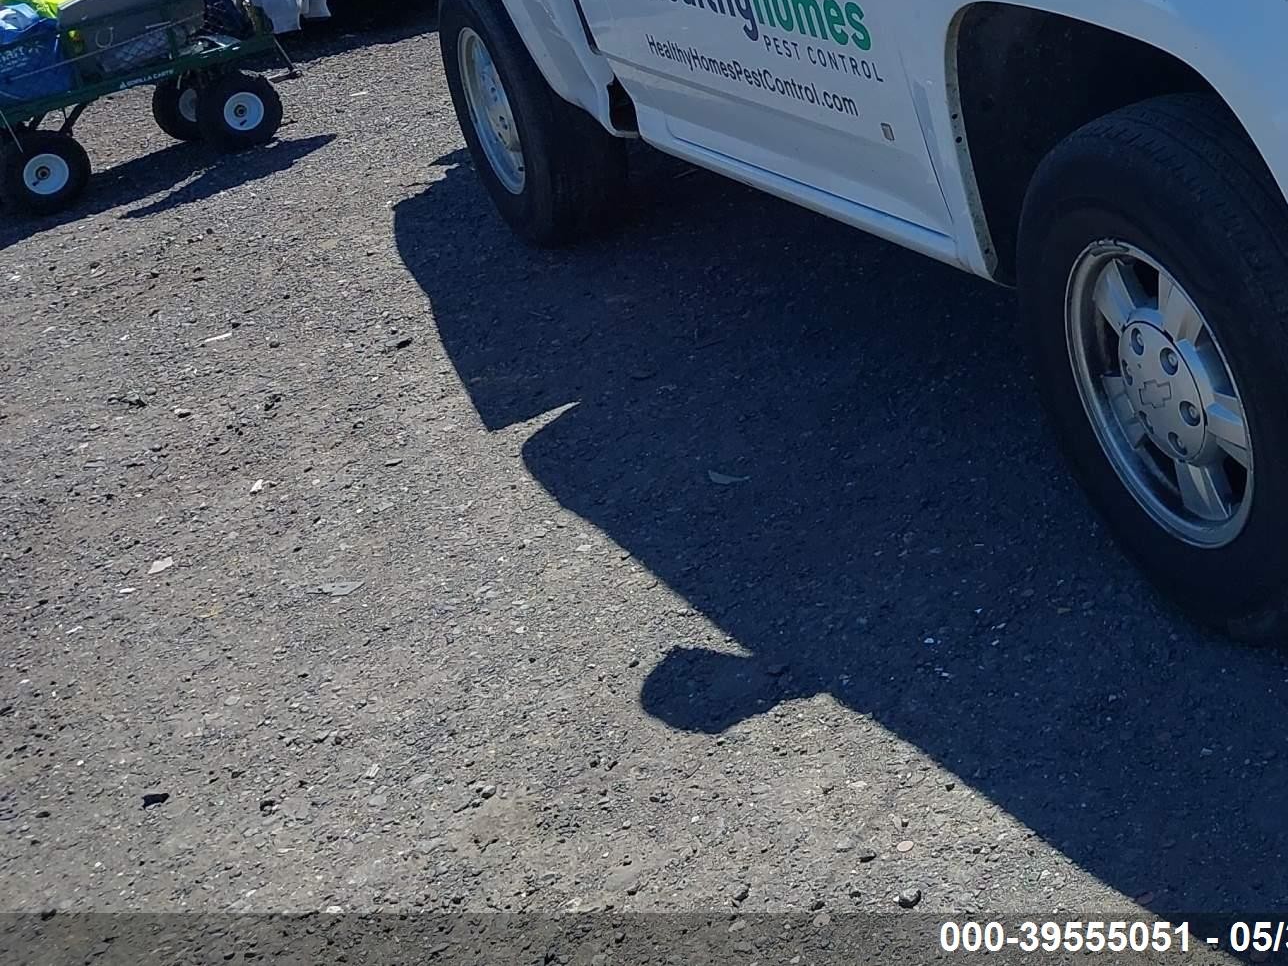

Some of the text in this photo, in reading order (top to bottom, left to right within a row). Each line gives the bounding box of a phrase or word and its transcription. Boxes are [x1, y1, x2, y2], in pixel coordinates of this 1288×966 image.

[646, 34, 860, 116] HealthyHomesPestControl.com
[763, 35, 885, 83] PEST CONTROL
